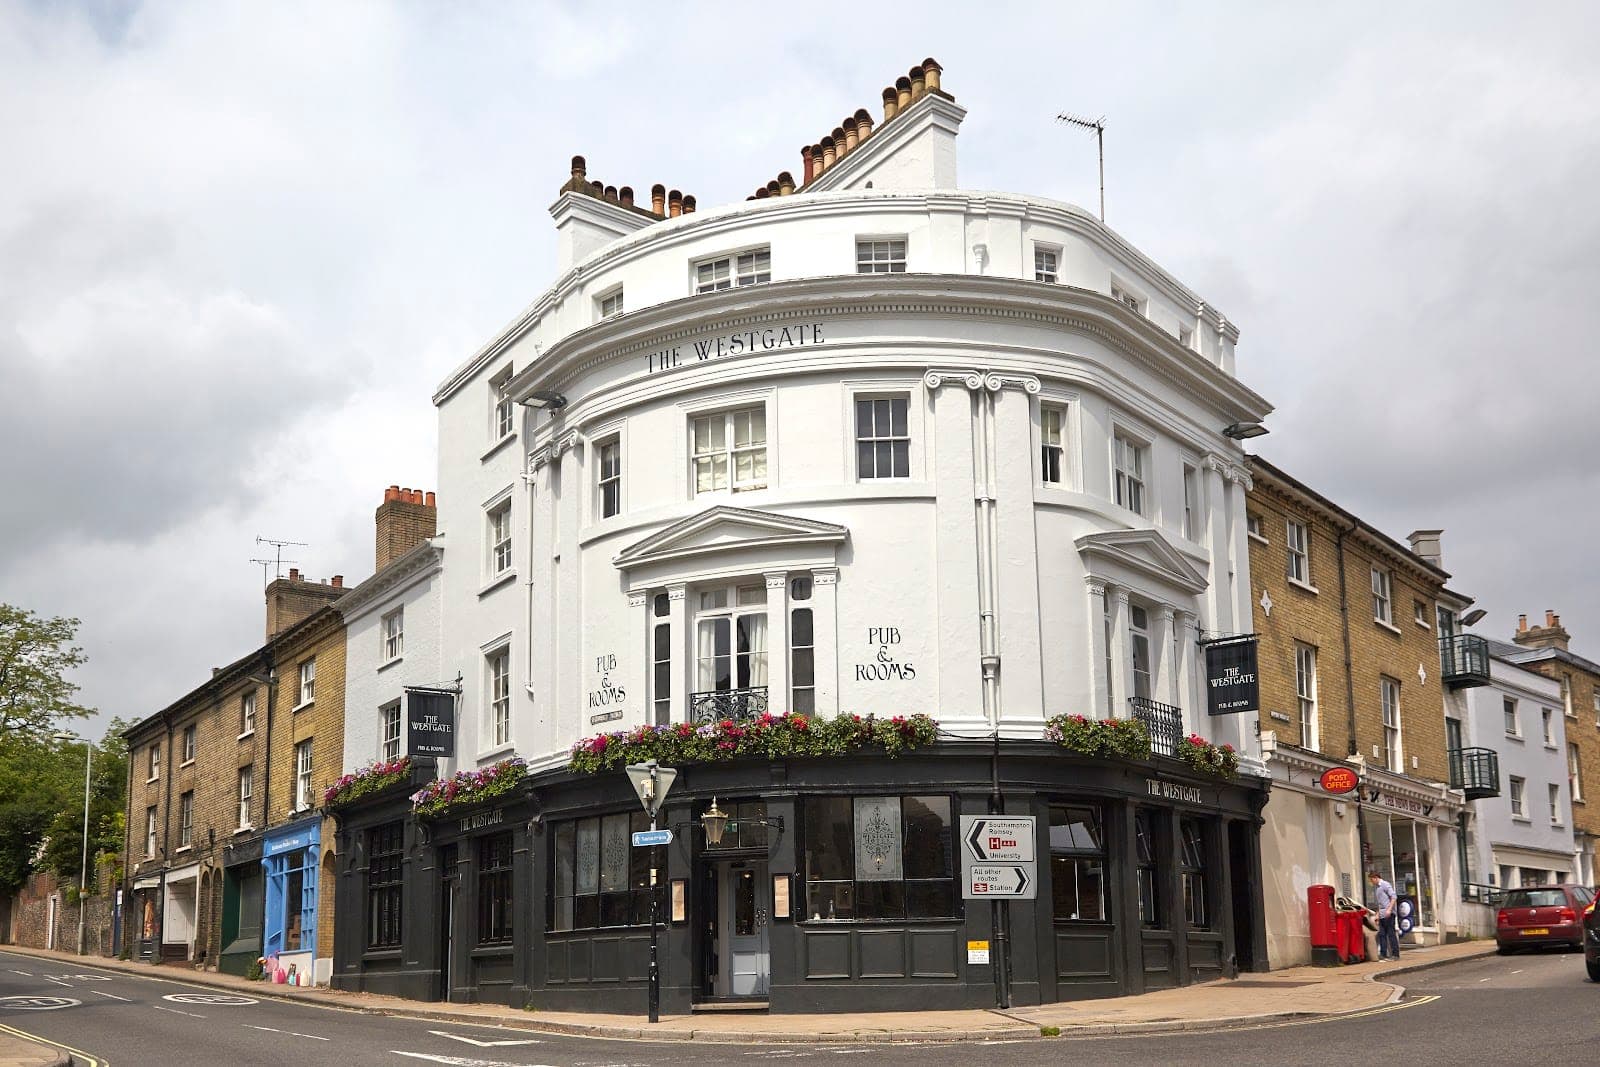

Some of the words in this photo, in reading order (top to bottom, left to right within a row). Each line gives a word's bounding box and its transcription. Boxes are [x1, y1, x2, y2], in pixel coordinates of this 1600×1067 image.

[644, 346, 682, 373] THE
[693, 323, 825, 361] WESTGATE
[868, 627, 901, 645] PUB
[877, 645, 893, 662] &
[597, 653, 617, 672] PUB
[855, 663, 916, 681] ROOMS
[1224, 667, 1240, 677] THE
[601, 672, 612, 688] &
[1210, 674, 1255, 688] WESTGATE
[589, 686, 626, 708] ROOMS
[411, 721, 452, 733] WESTGATE
[424, 715, 439, 724] THE
[1326, 780, 1352, 789] OFFICE
[1328, 773, 1348, 782] POST
[1145, 778, 1161, 796] THE
[1162, 781, 1202, 804] WESTGATE
[471, 809, 503, 829] WESTGATE
[988, 821, 1030, 829] Southampton
[988, 828, 1013, 836] Romsey
[989, 852, 1021, 860] University
